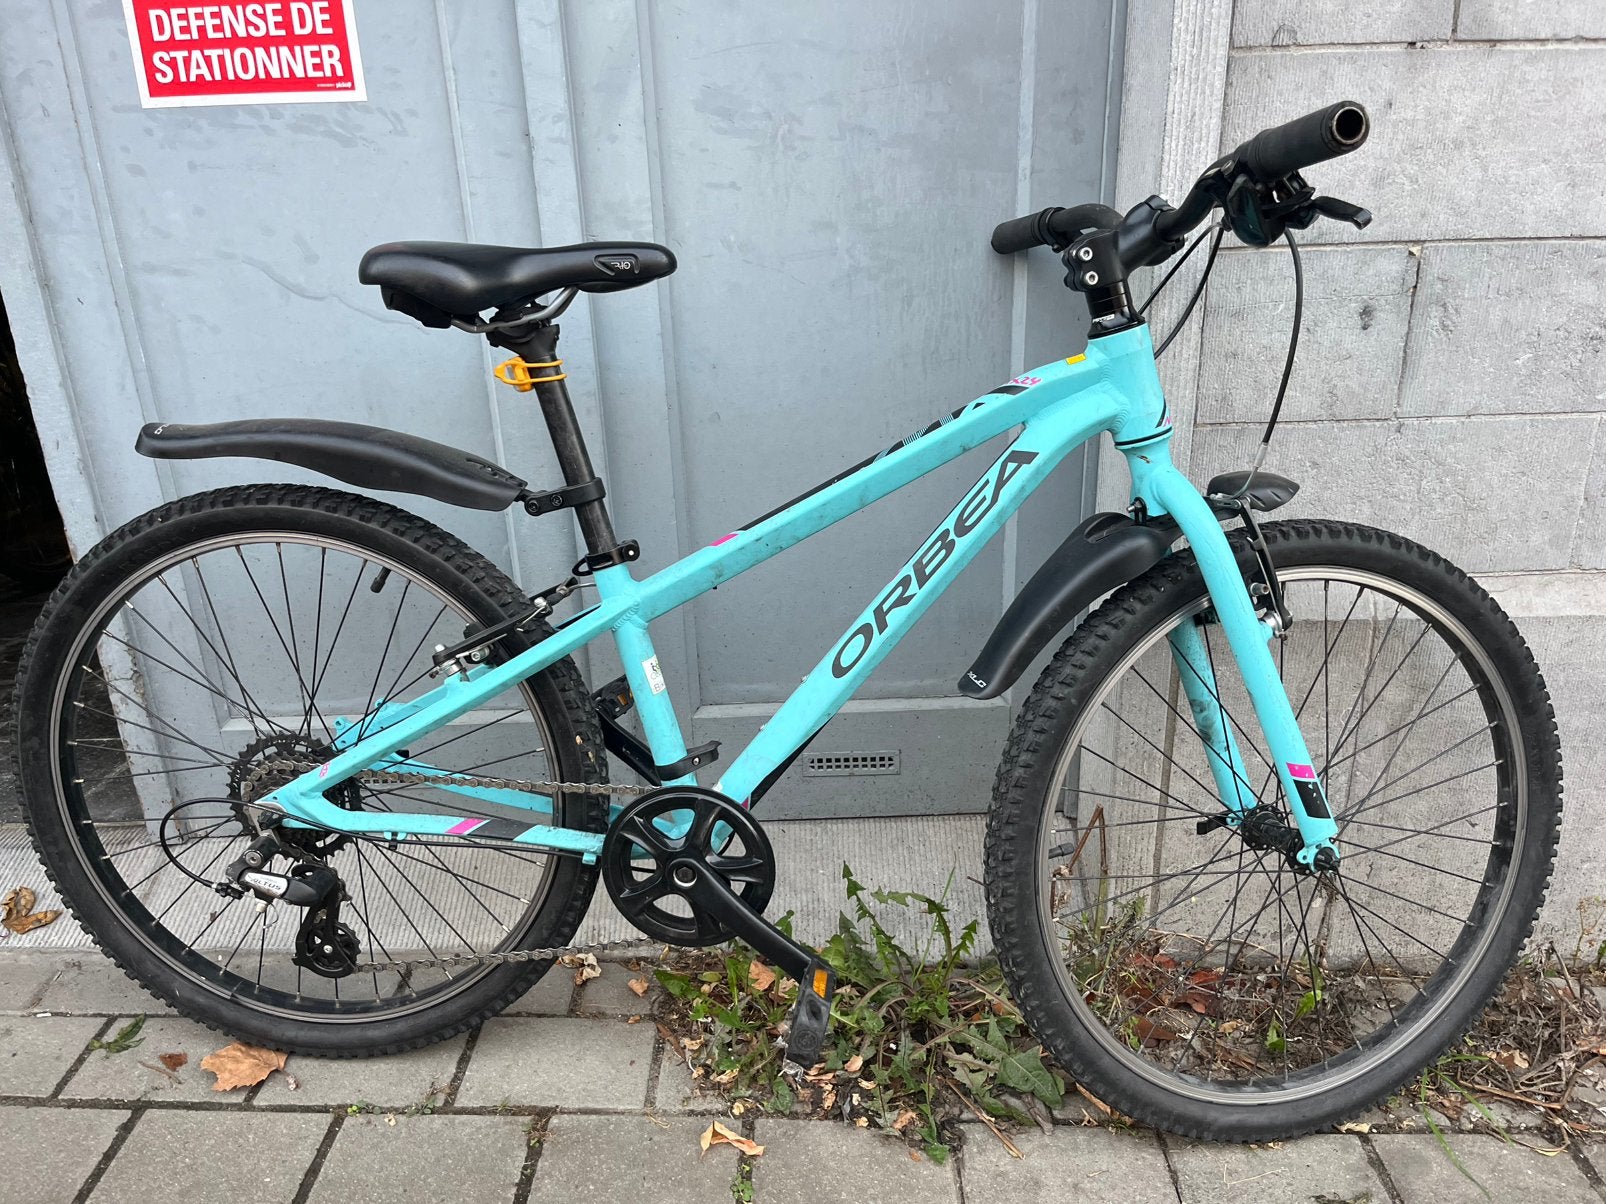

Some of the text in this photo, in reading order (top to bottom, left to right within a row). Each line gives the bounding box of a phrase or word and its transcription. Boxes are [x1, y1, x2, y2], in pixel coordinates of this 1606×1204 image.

[148, 1, 334, 42] DEFENSE DE
[152, 44, 345, 84] STATIONNER
[831, 449, 1041, 679] ORBEA
